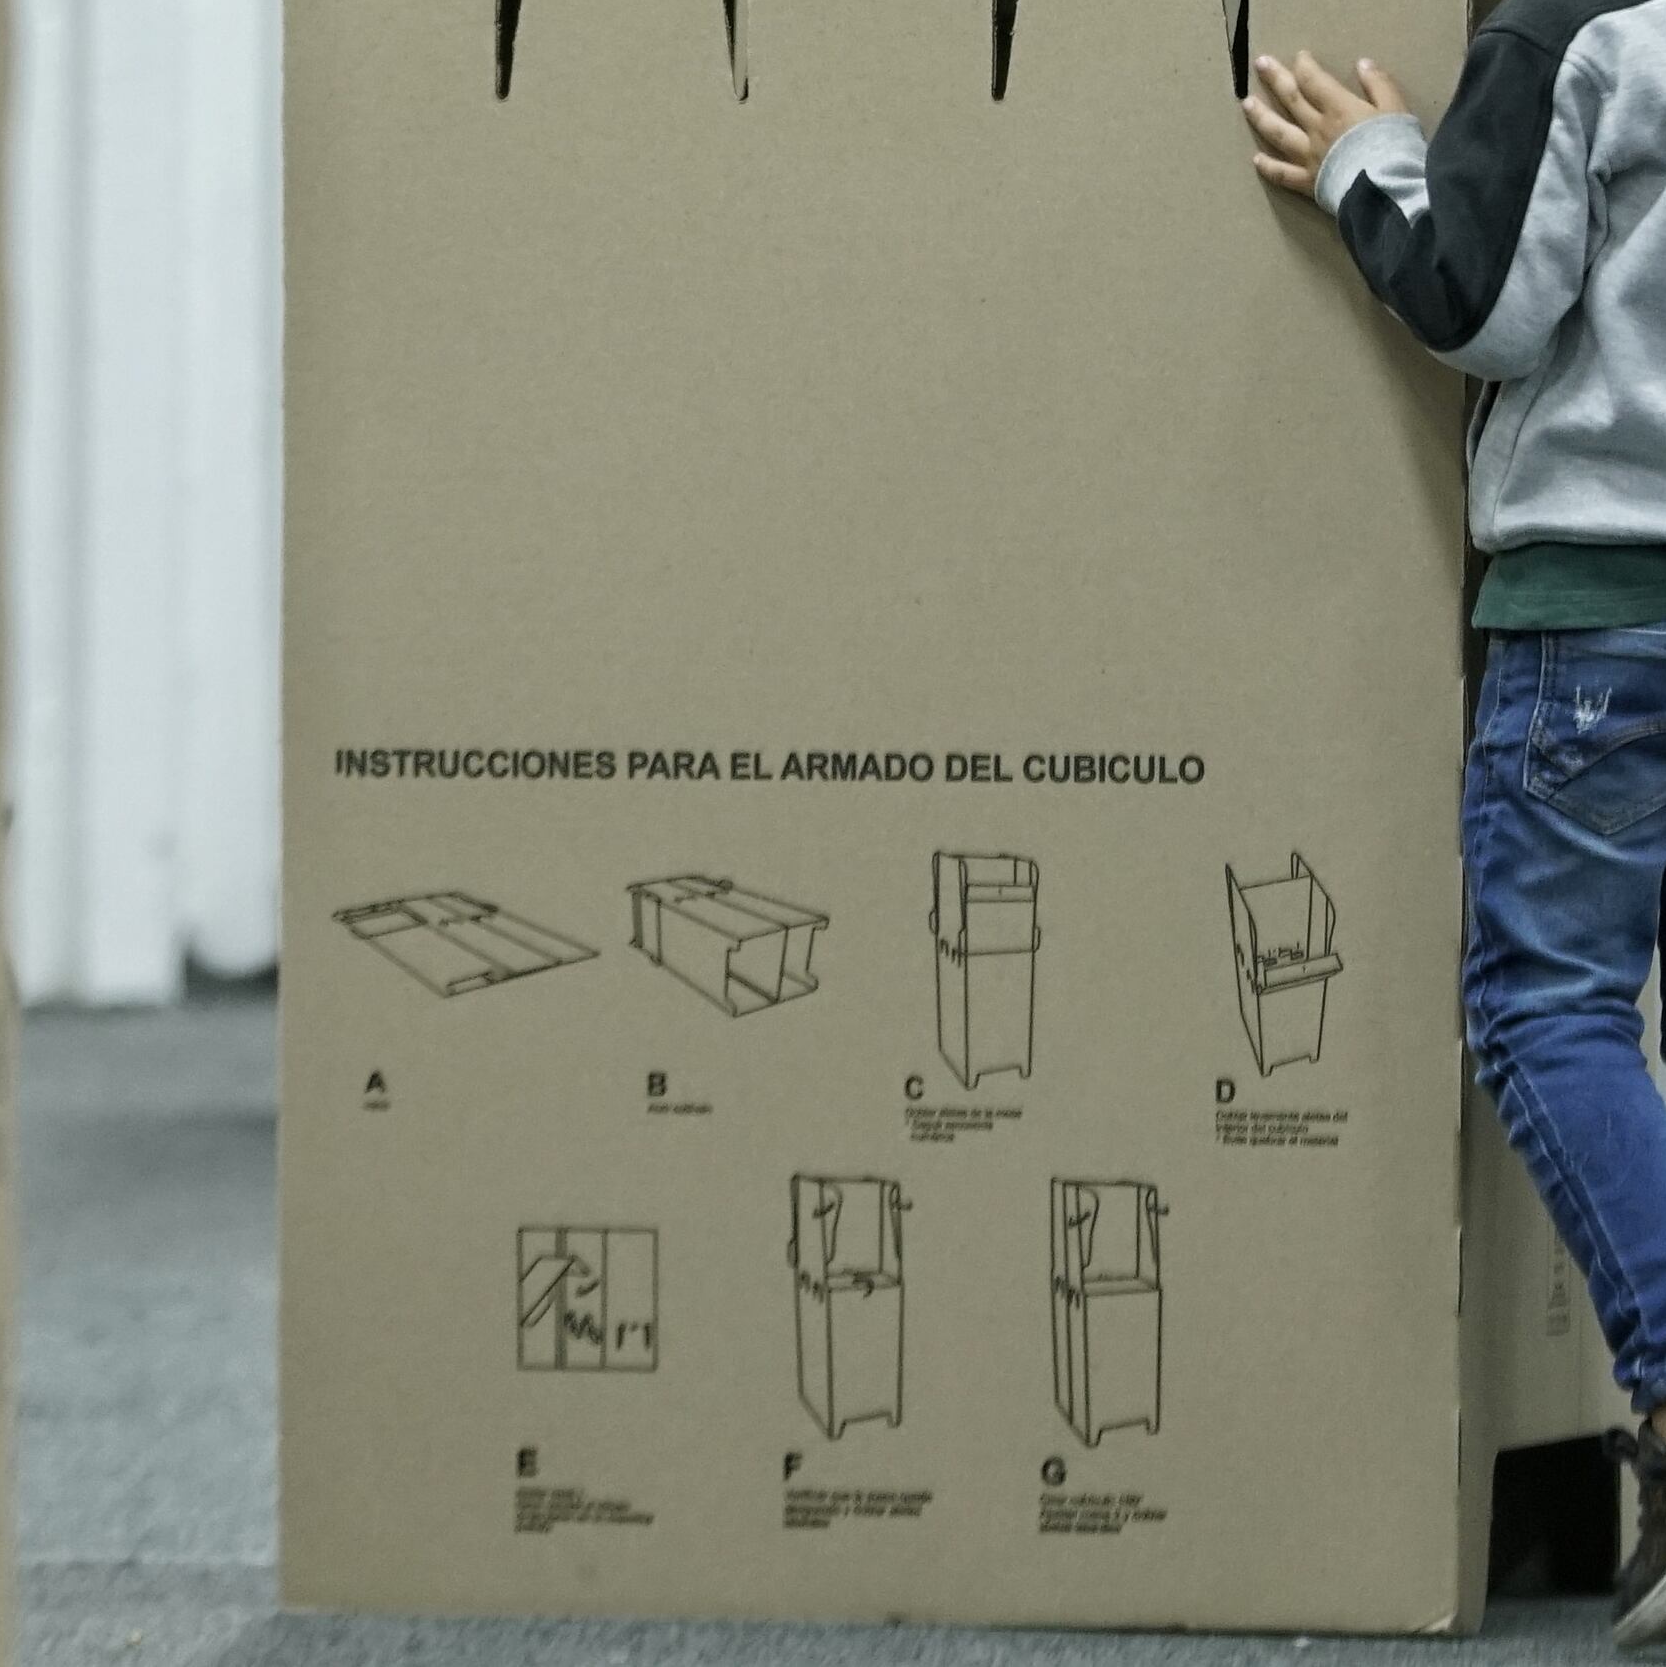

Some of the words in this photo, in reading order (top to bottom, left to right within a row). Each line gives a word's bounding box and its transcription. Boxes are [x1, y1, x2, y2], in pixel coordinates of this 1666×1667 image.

[334, 748, 617, 780] INSTRUCCIONES
[627, 750, 721, 781] PARA
[730, 751, 773, 781] EL
[780, 751, 935, 783] ARMADO
[945, 752, 1014, 783] DEL
[1022, 753, 1206, 785] CUBICULO
[365, 1071, 386, 1094] A
[647, 1072, 668, 1097] B
[904, 1075, 924, 1100] C
[1215, 1078, 1236, 1104] D
[517, 1448, 538, 1476] E
[783, 1452, 803, 1481] F
[1041, 1456, 1067, 1486] G
